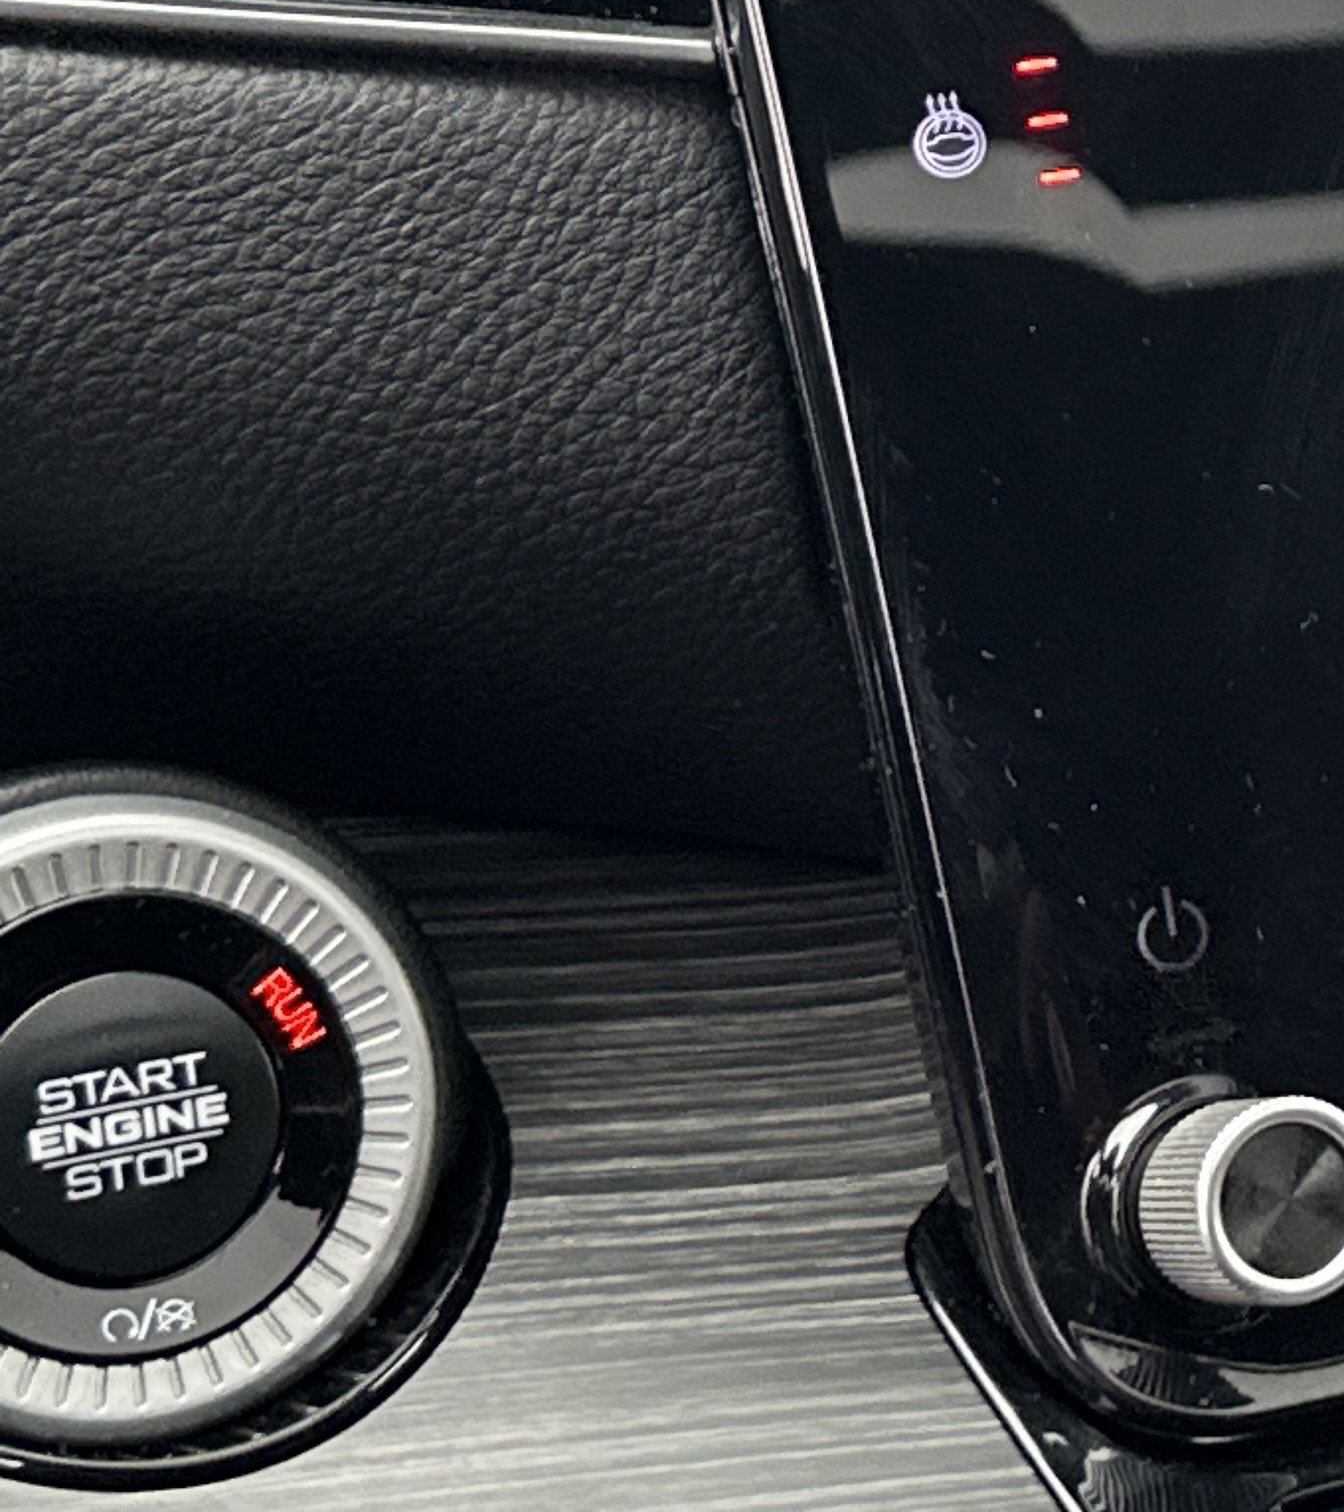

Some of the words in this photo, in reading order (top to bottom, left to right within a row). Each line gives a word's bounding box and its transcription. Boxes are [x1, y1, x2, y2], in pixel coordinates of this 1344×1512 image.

[250, 965, 327, 1052] RUN
[37, 1051, 207, 1114] START
[27, 1091, 231, 1165] ENGINE
[64, 1141, 209, 1203] STOP
